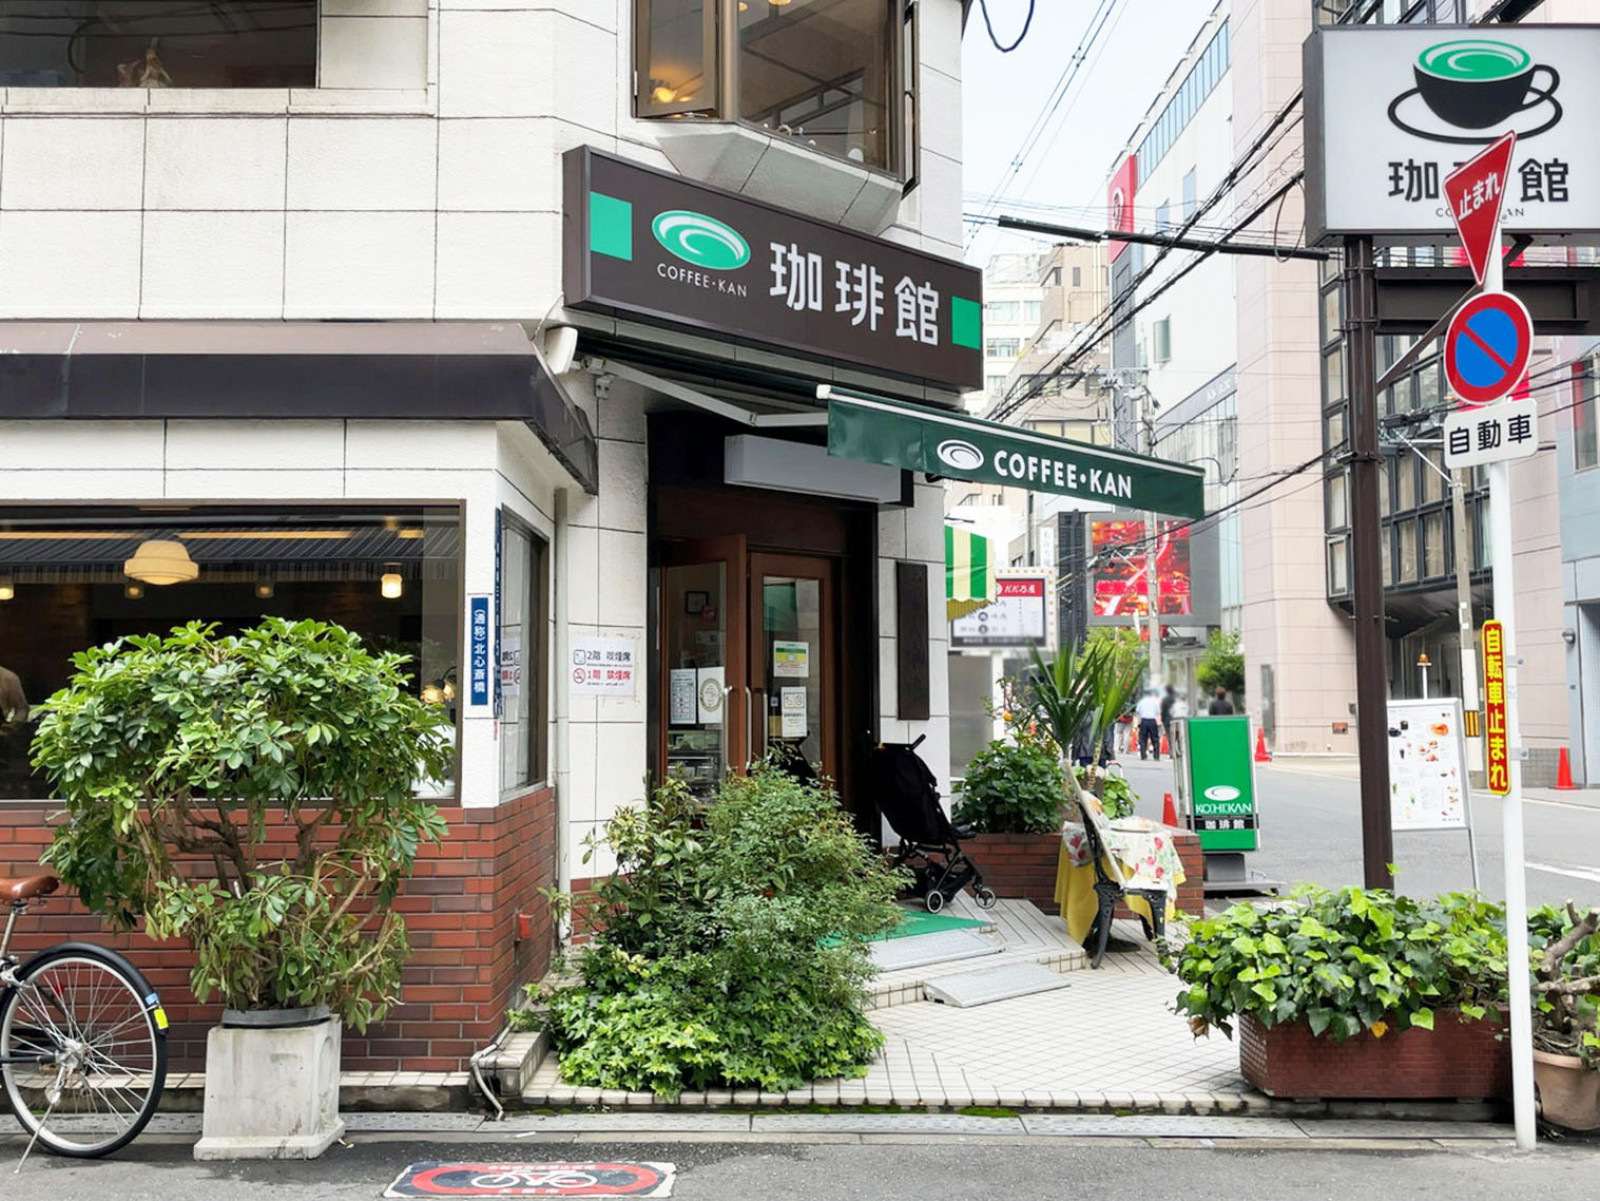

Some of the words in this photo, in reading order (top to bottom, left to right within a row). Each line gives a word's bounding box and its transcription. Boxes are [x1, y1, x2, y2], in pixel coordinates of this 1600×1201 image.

[1388, 157, 1569, 202] 珈館
[1458, 172, 1500, 221] 止まれ
[769, 241, 940, 347] 珈琲館
[1449, 414, 1532, 456] 自動車
[1486, 627, 1507, 788] 自転車止まれ
